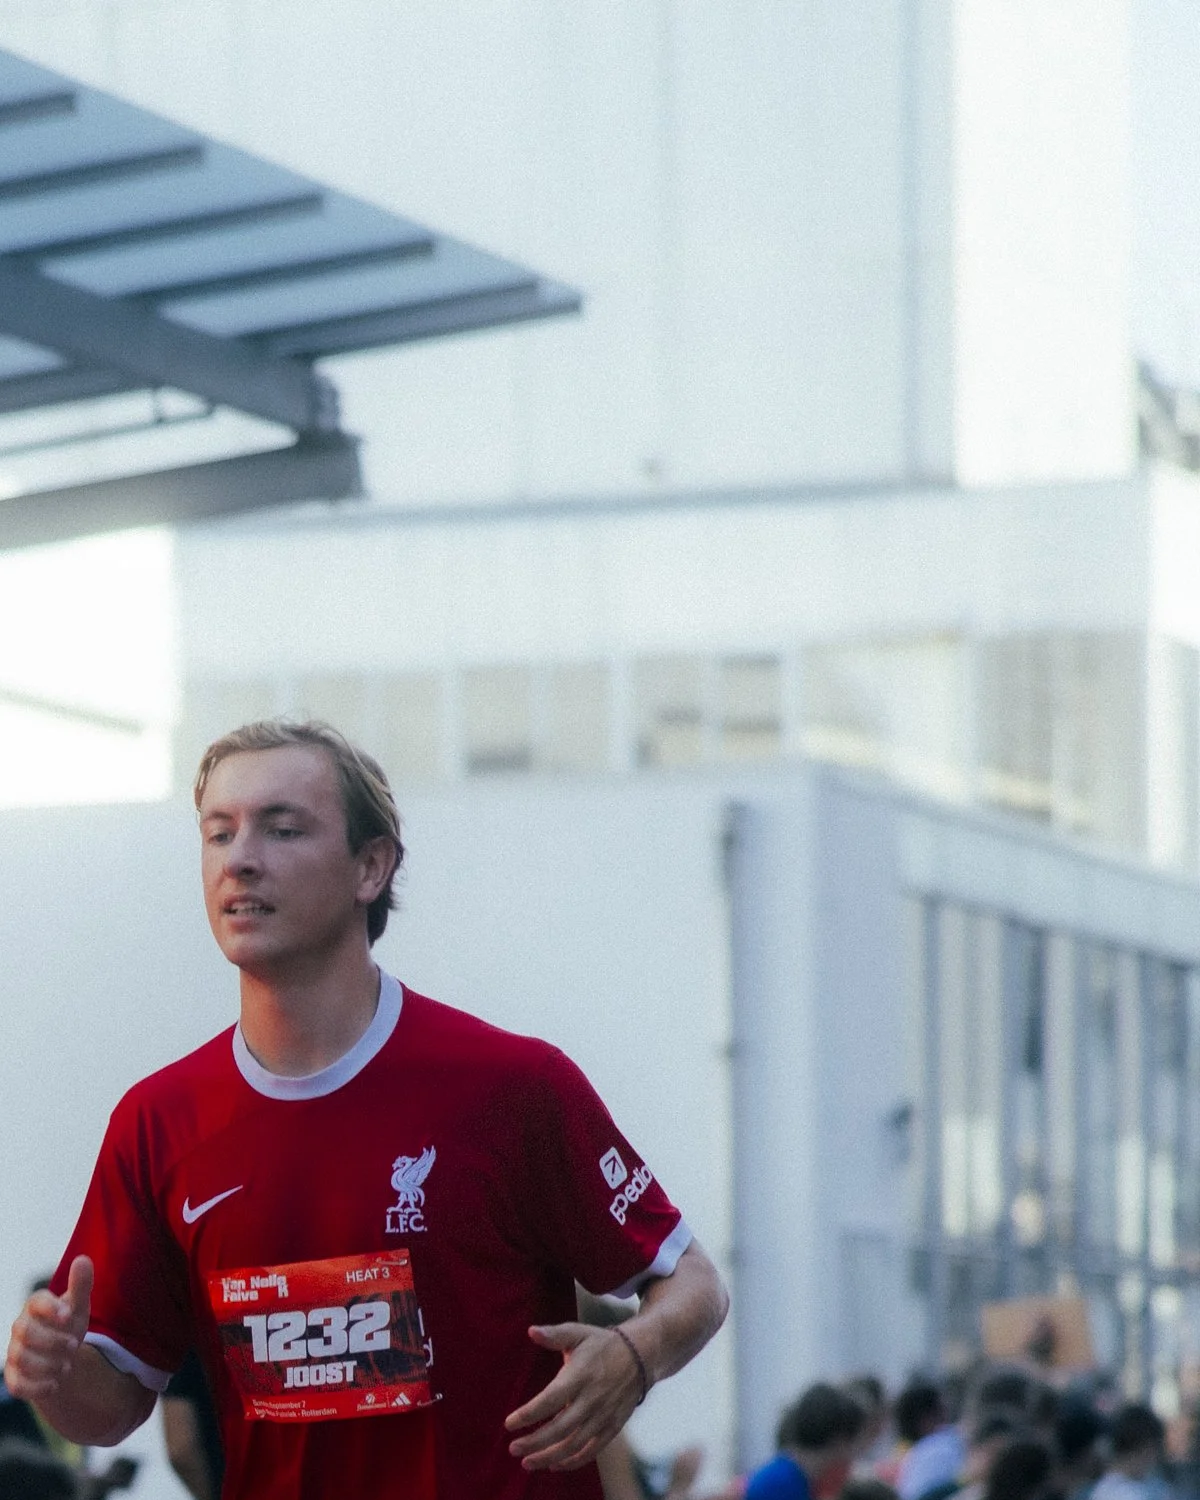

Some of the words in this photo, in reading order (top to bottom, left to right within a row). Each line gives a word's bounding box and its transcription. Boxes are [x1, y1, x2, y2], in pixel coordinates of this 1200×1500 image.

[346, 1268, 379, 1283] HEAT
[382, 1266, 390, 1279] 3
[244, 1301, 390, 1362] 1232
[284, 1360, 358, 1389] JOOST
[301, 1408, 338, 1417] Rotterdam
